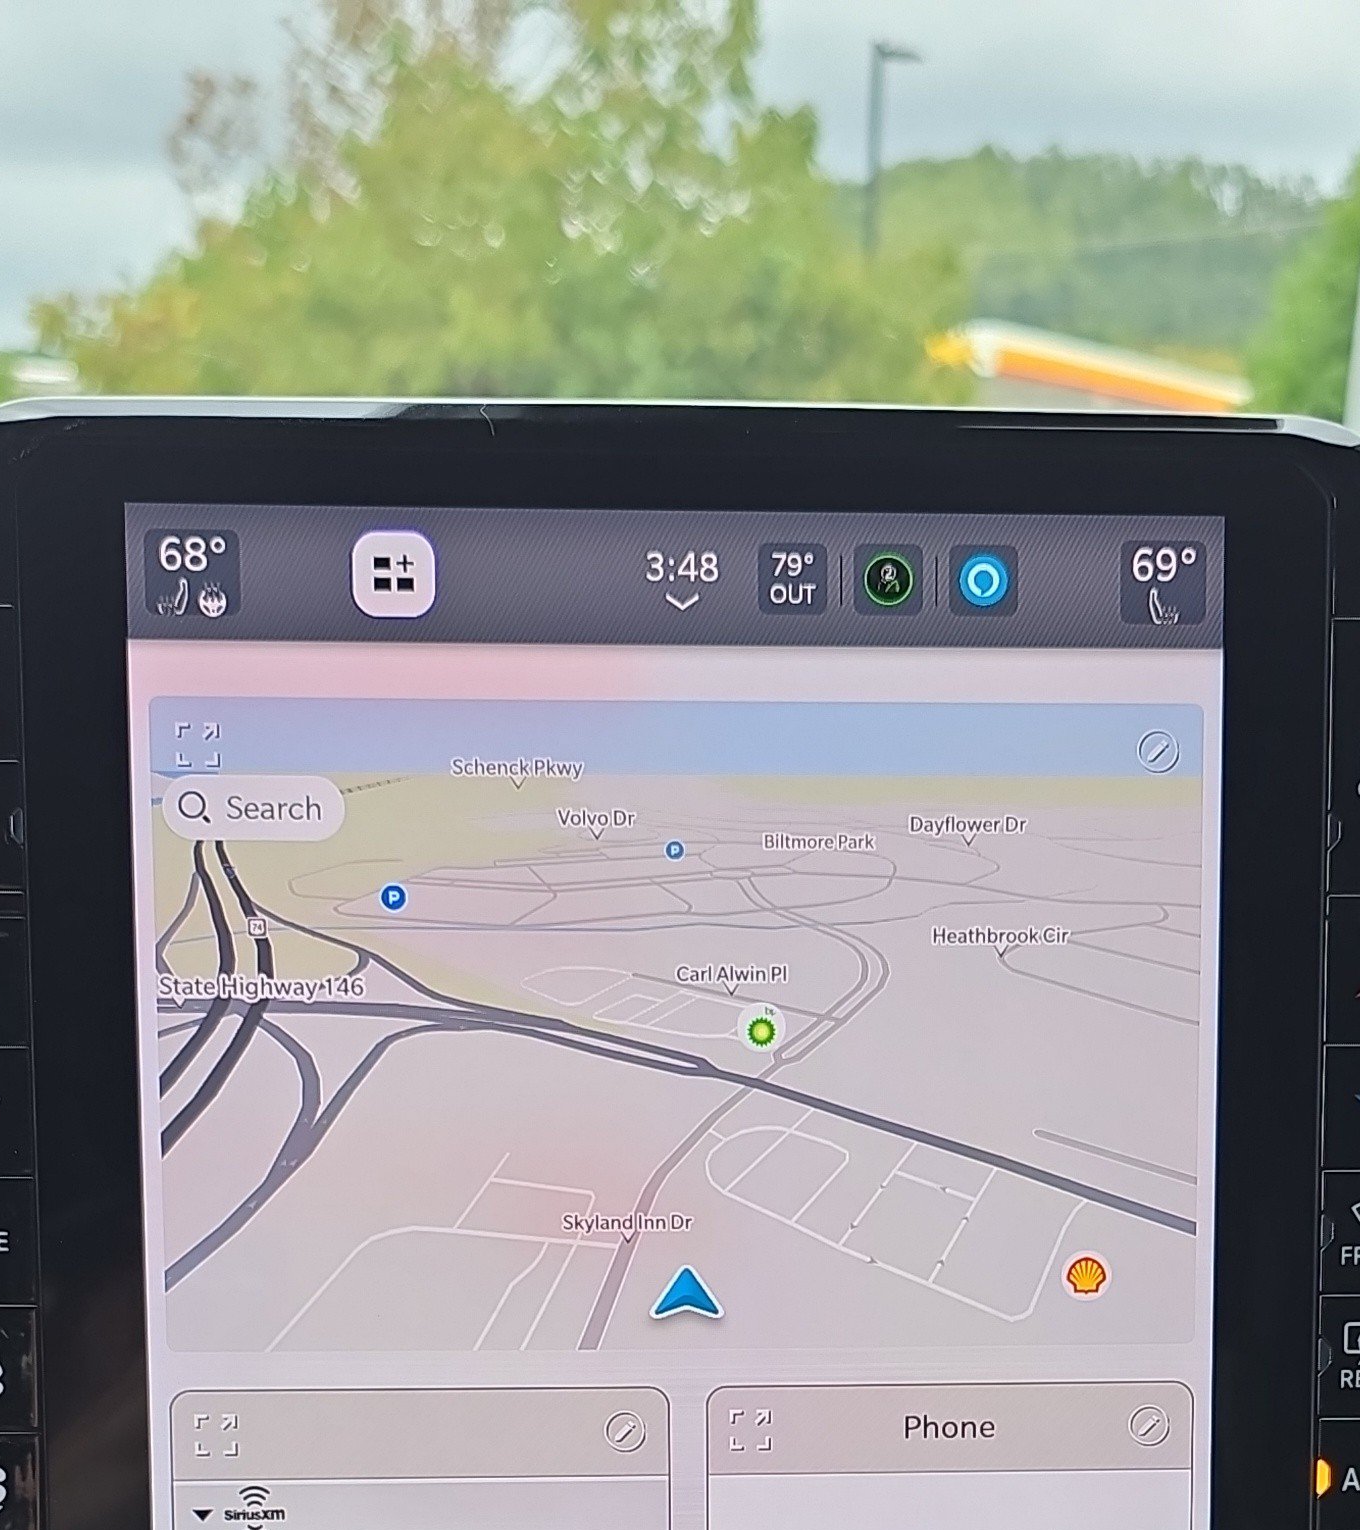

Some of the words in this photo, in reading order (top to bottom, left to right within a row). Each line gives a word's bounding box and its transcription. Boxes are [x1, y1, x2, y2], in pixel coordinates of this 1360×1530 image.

[159, 536, 226, 571] 68°
[771, 552, 814, 577] 79°
[1132, 547, 1197, 581] 69°
[645, 552, 719, 582] 3:48
[770, 584, 816, 605] OUT
[451, 758, 529, 777] Schenck
[533, 760, 583, 780] Pkwy
[227, 795, 323, 822] Search
[557, 809, 608, 828] Volvo
[612, 810, 635, 828] Dr
[910, 816, 1000, 837] Dayflower
[1004, 817, 1027, 834] Dr
[763, 834, 834, 851] Biltmore
[838, 834, 875, 851] Park
[933, 926, 1039, 945] Heathbrook
[1043, 927, 1070, 945] Cir
[676, 965, 713, 984] Carl
[716, 965, 767, 984] Alwin
[159, 977, 215, 996] State
[222, 977, 319, 1000] Highway
[325, 977, 364, 996] 146
[563, 1214, 633, 1234] Skyland
[637, 1214, 666, 1230] Inn
[670, 1214, 692, 1230] Dr
[904, 1415, 996, 1440] Phone
